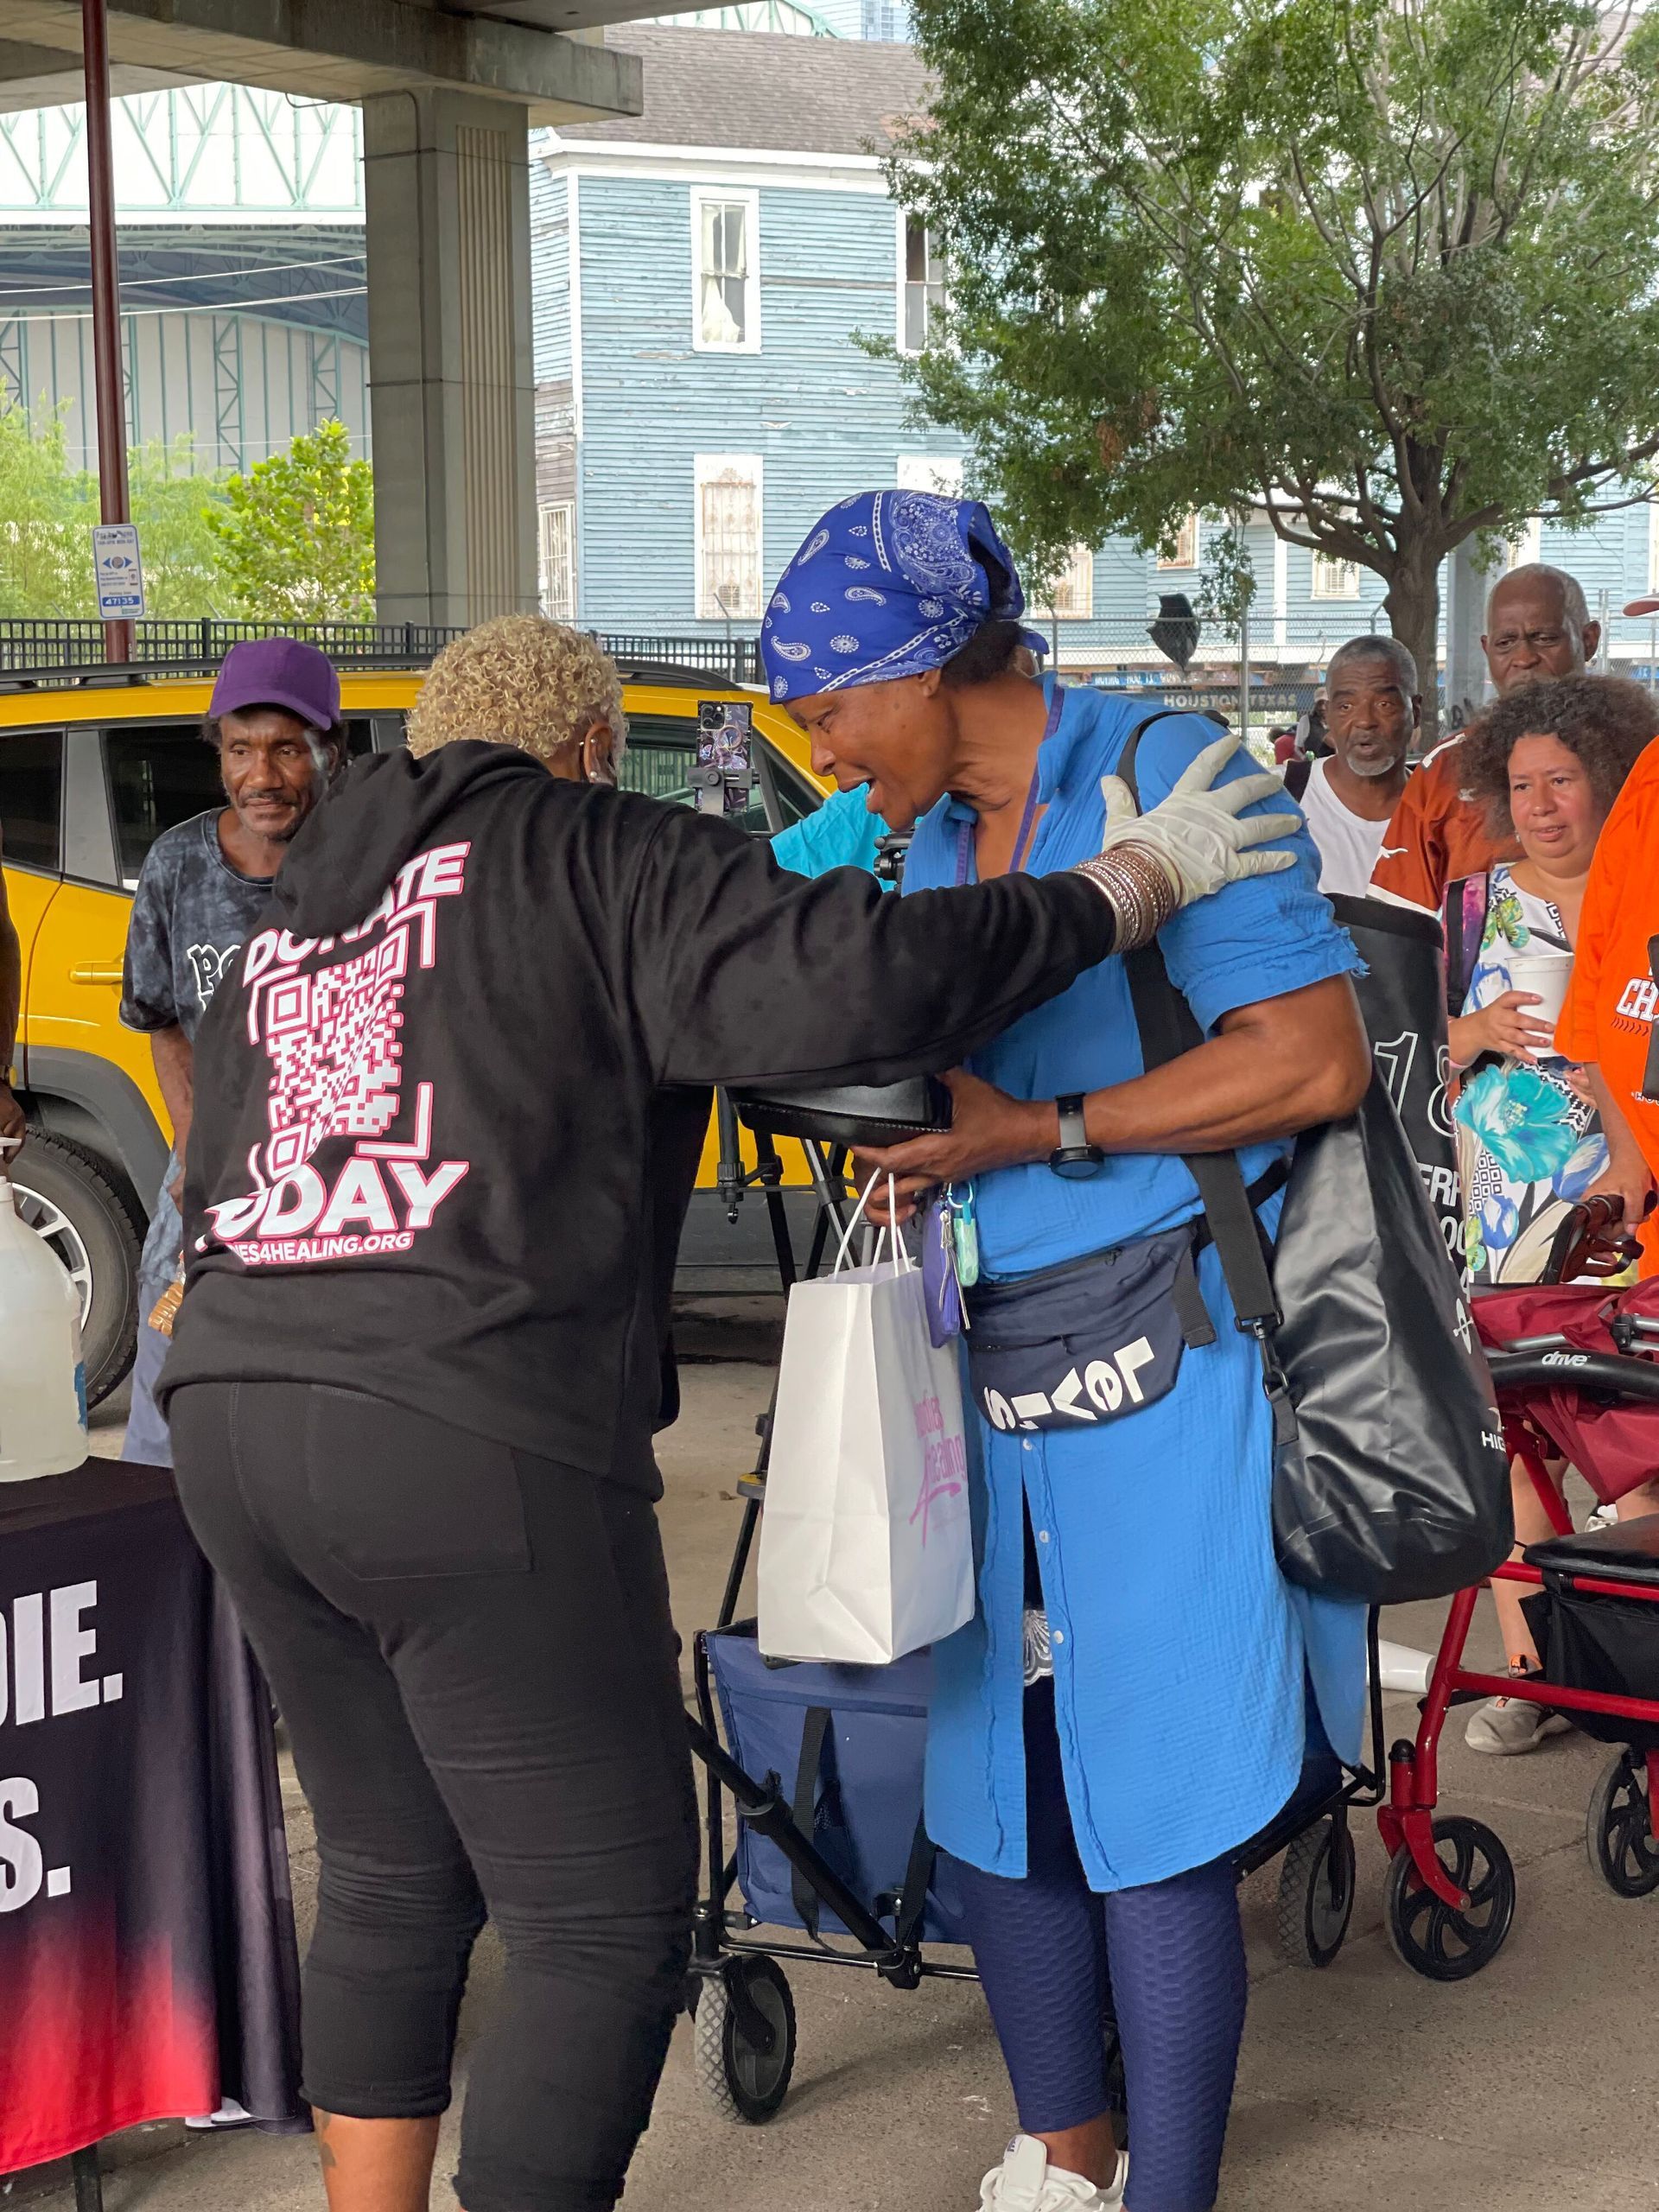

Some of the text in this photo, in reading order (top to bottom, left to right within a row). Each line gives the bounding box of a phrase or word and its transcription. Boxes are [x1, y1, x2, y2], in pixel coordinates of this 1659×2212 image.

[1164, 694, 1296, 707] HOUSTON TEXAS
[1541, 1351, 1588, 1366] drive
